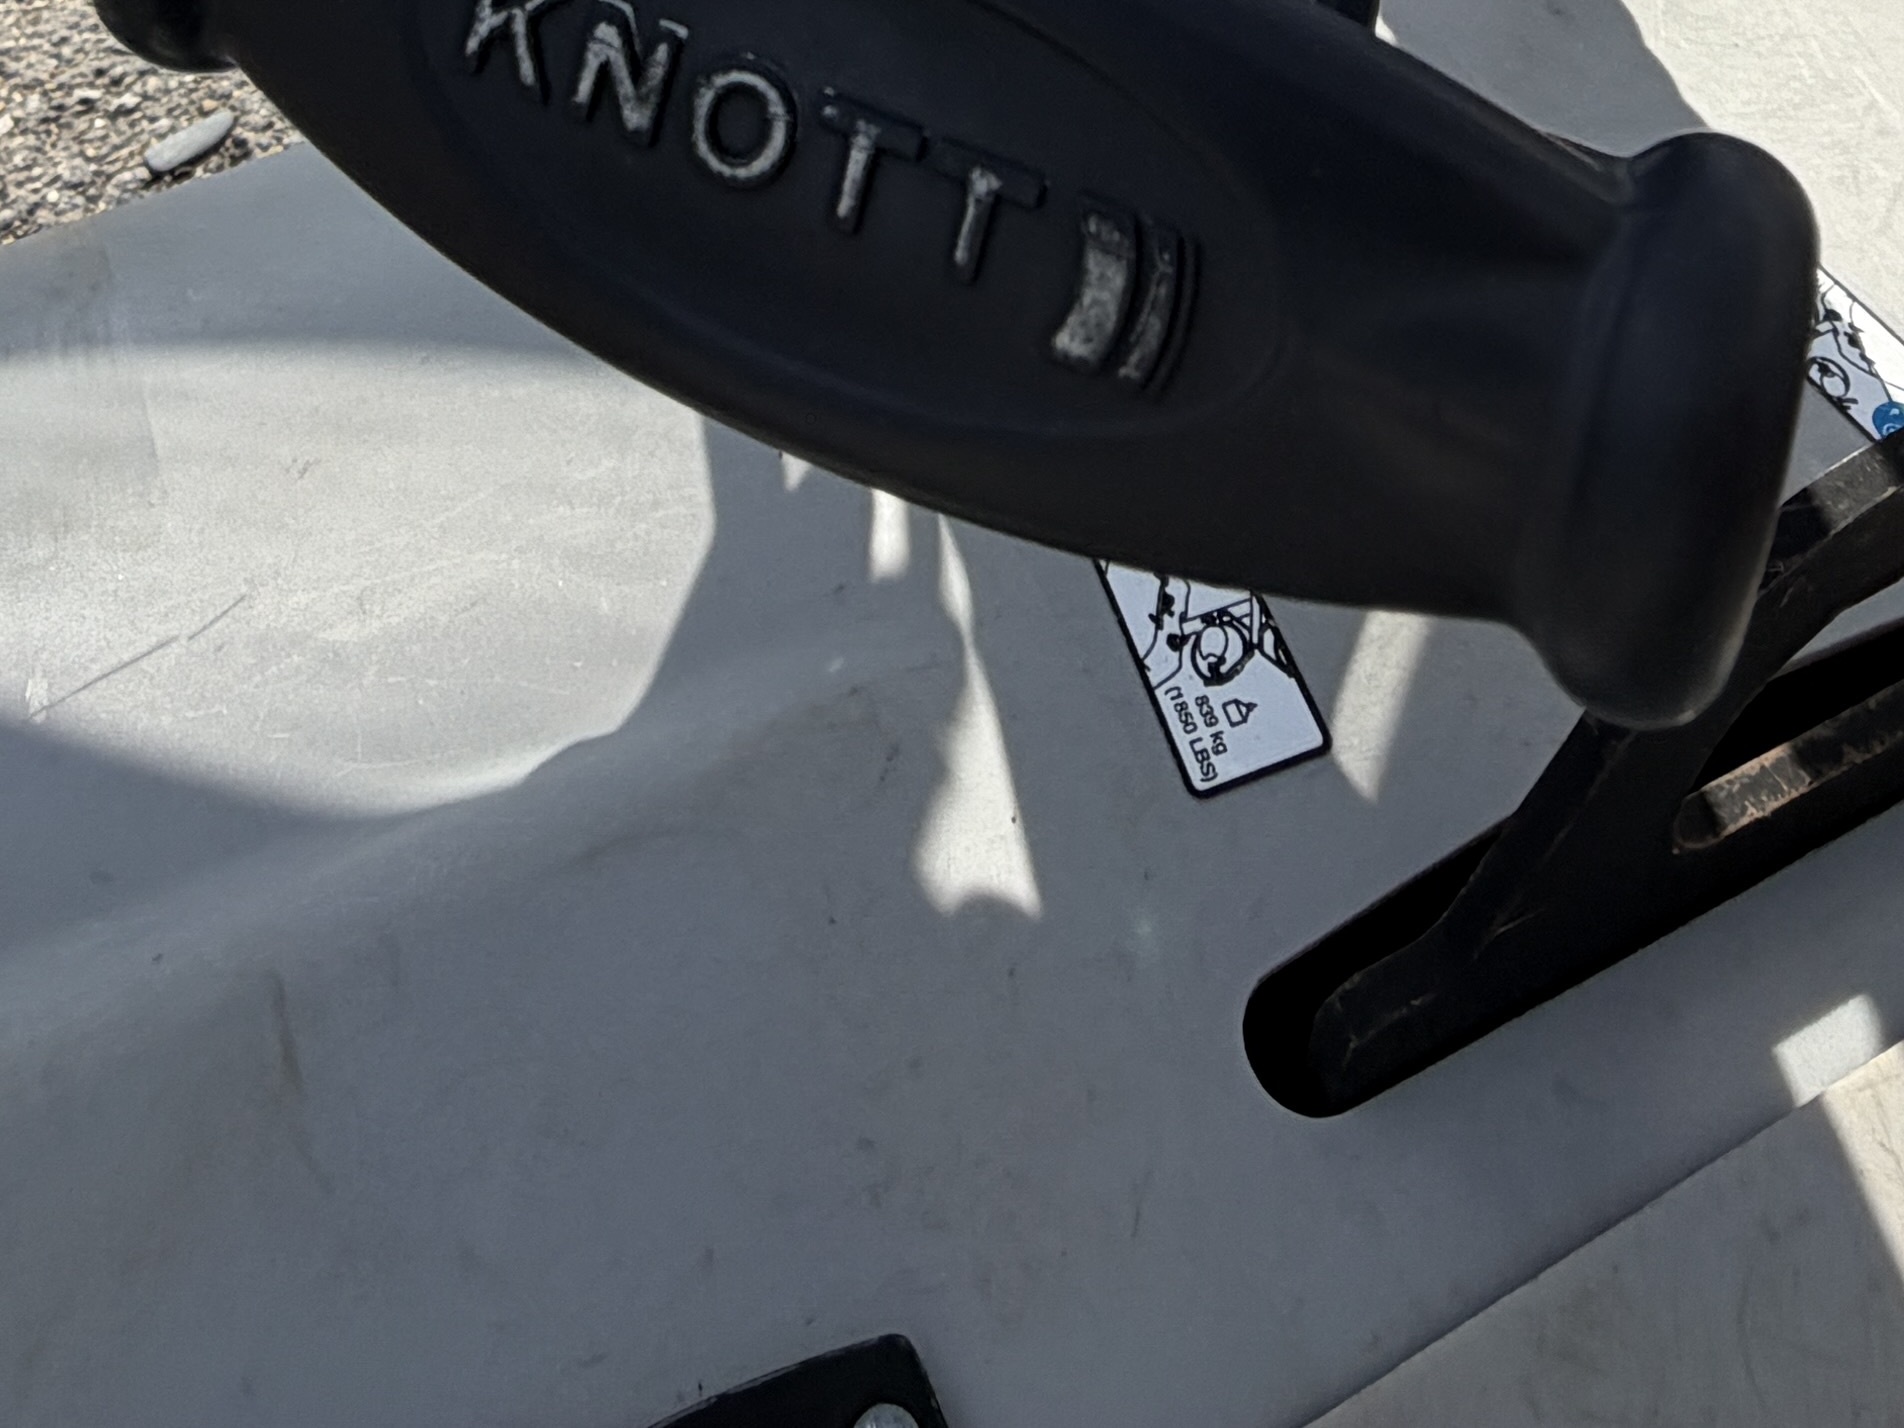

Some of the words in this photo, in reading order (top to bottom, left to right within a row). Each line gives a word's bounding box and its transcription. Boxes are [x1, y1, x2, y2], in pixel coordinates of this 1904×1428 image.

[1164, 685, 1198, 735] (1850
[1189, 737, 1219, 782] LBS)
[1194, 694, 1219, 728] 839
[1210, 730, 1228, 756] kg
